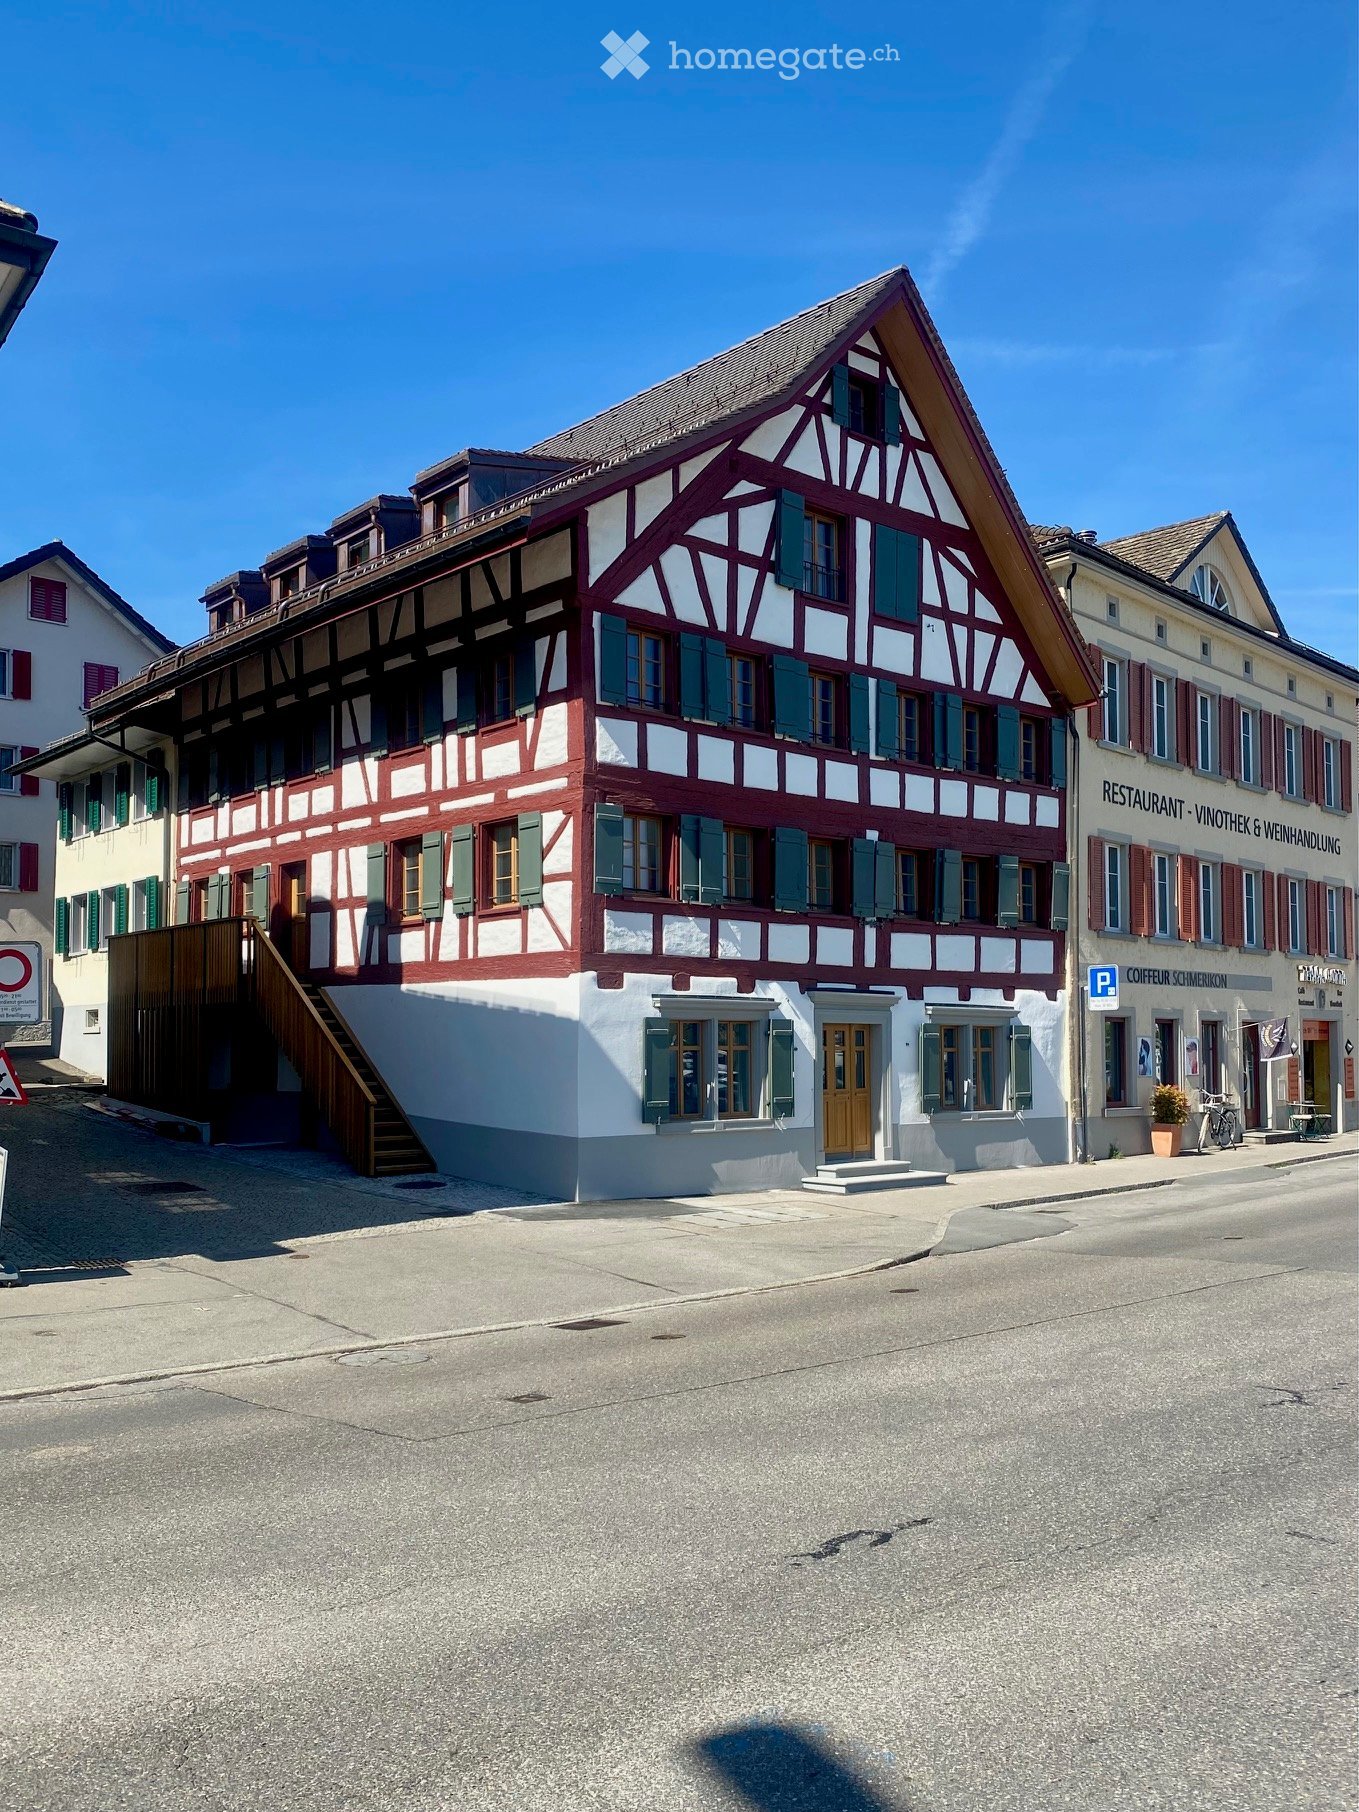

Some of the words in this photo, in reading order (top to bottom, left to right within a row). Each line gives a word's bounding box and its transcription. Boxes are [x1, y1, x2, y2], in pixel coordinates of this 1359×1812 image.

[1103, 780, 1185, 820] RESTAURANT
[1195, 803, 1251, 836] VINOTHEK
[1253, 818, 1262, 838] &
[1264, 820, 1341, 856] WEINHANDLUNG
[1097, 972, 1110, 994] P
[1126, 967, 1170, 986] COIFFEUR
[1172, 970, 1228, 989] SCHMERIKON
